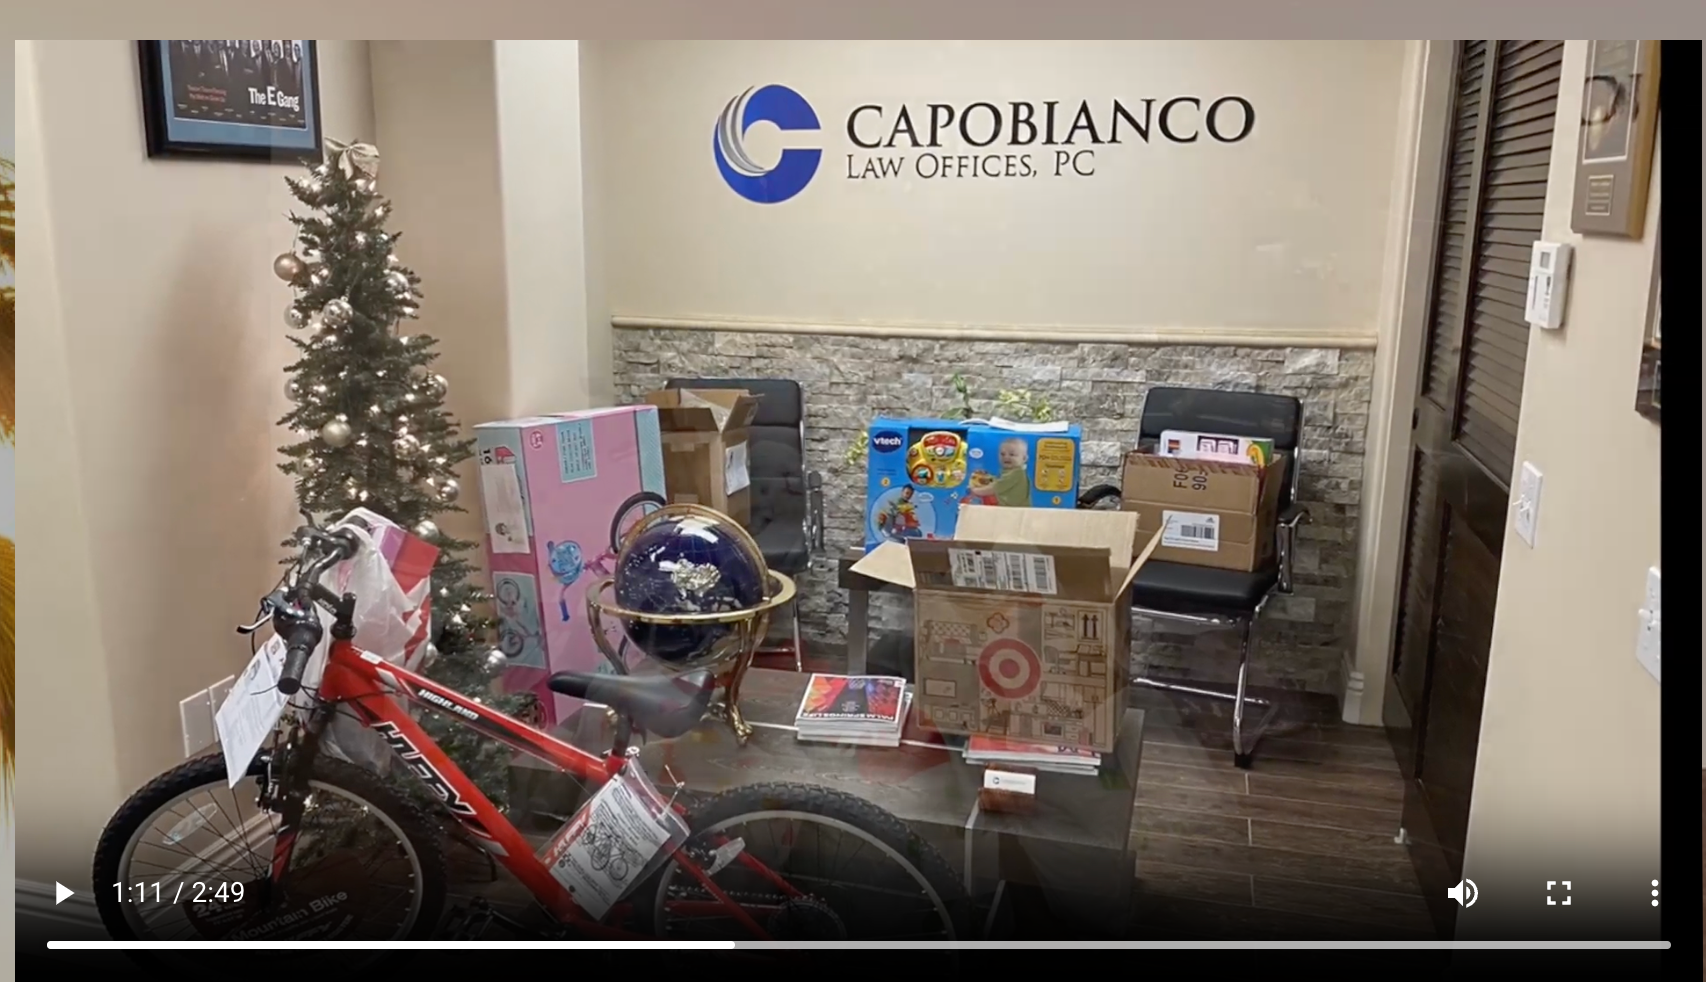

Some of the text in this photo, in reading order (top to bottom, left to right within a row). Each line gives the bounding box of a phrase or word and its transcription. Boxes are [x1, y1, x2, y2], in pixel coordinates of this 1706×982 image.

[249, 87, 266, 106] The
[267, 86, 277, 105] E
[277, 90, 300, 112] Gang
[846, 95, 1256, 149] CAPOBIANCO
[846, 150, 1096, 180] LAW OFFICES, PC
[873, 434, 901, 447] vtech
[418, 688, 479, 721] HIGHLAND
[233, 908, 310, 941] Mountain
[308, 890, 349, 913] Bike
